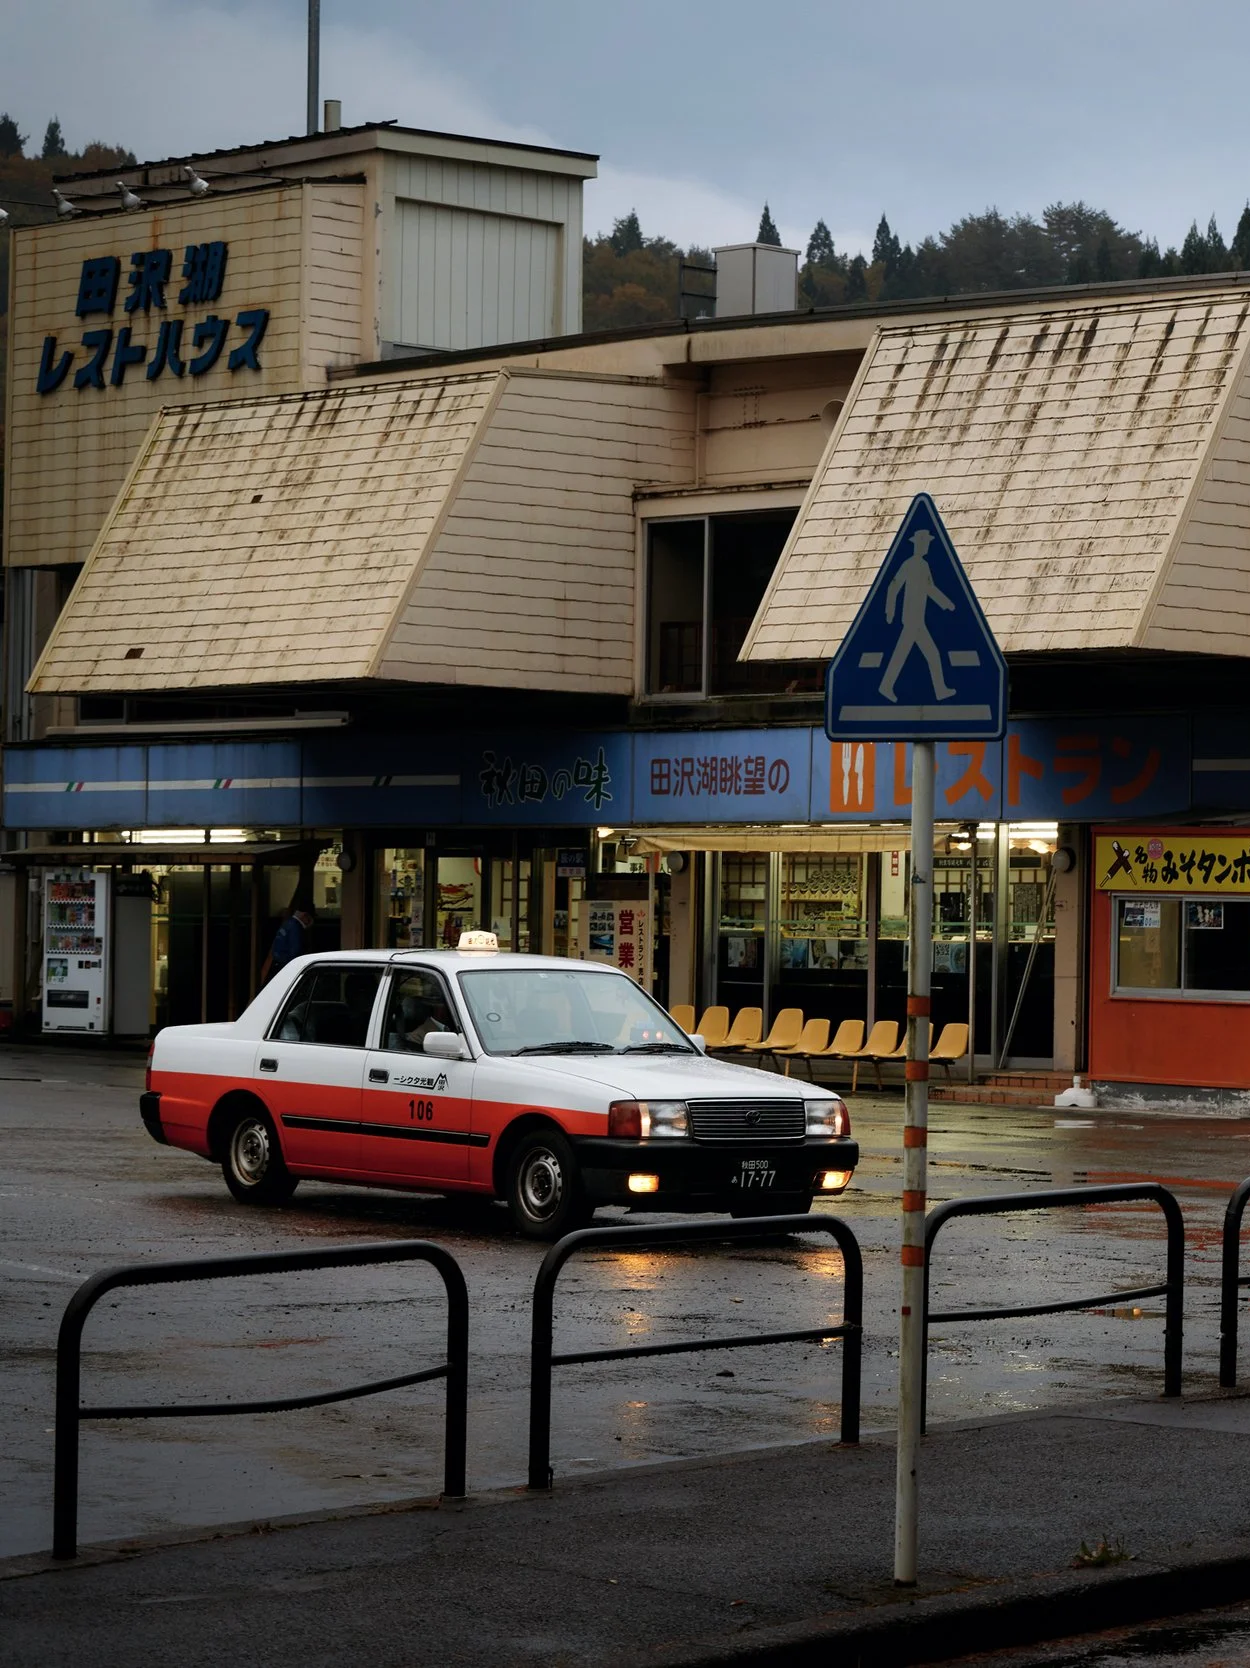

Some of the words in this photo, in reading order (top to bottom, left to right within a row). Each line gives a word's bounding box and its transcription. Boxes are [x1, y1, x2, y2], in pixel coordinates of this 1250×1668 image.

[76, 240, 228, 317] 田沢湖
[36, 308, 270, 394] レストハウス
[478, 746, 613, 811] 秋田の味
[650, 755, 790, 797] 田沢湖眺望の
[1135, 846, 1158, 883] 名物
[408, 1099, 434, 1121] 106
[740, 1170, 776, 1188] 17-77
